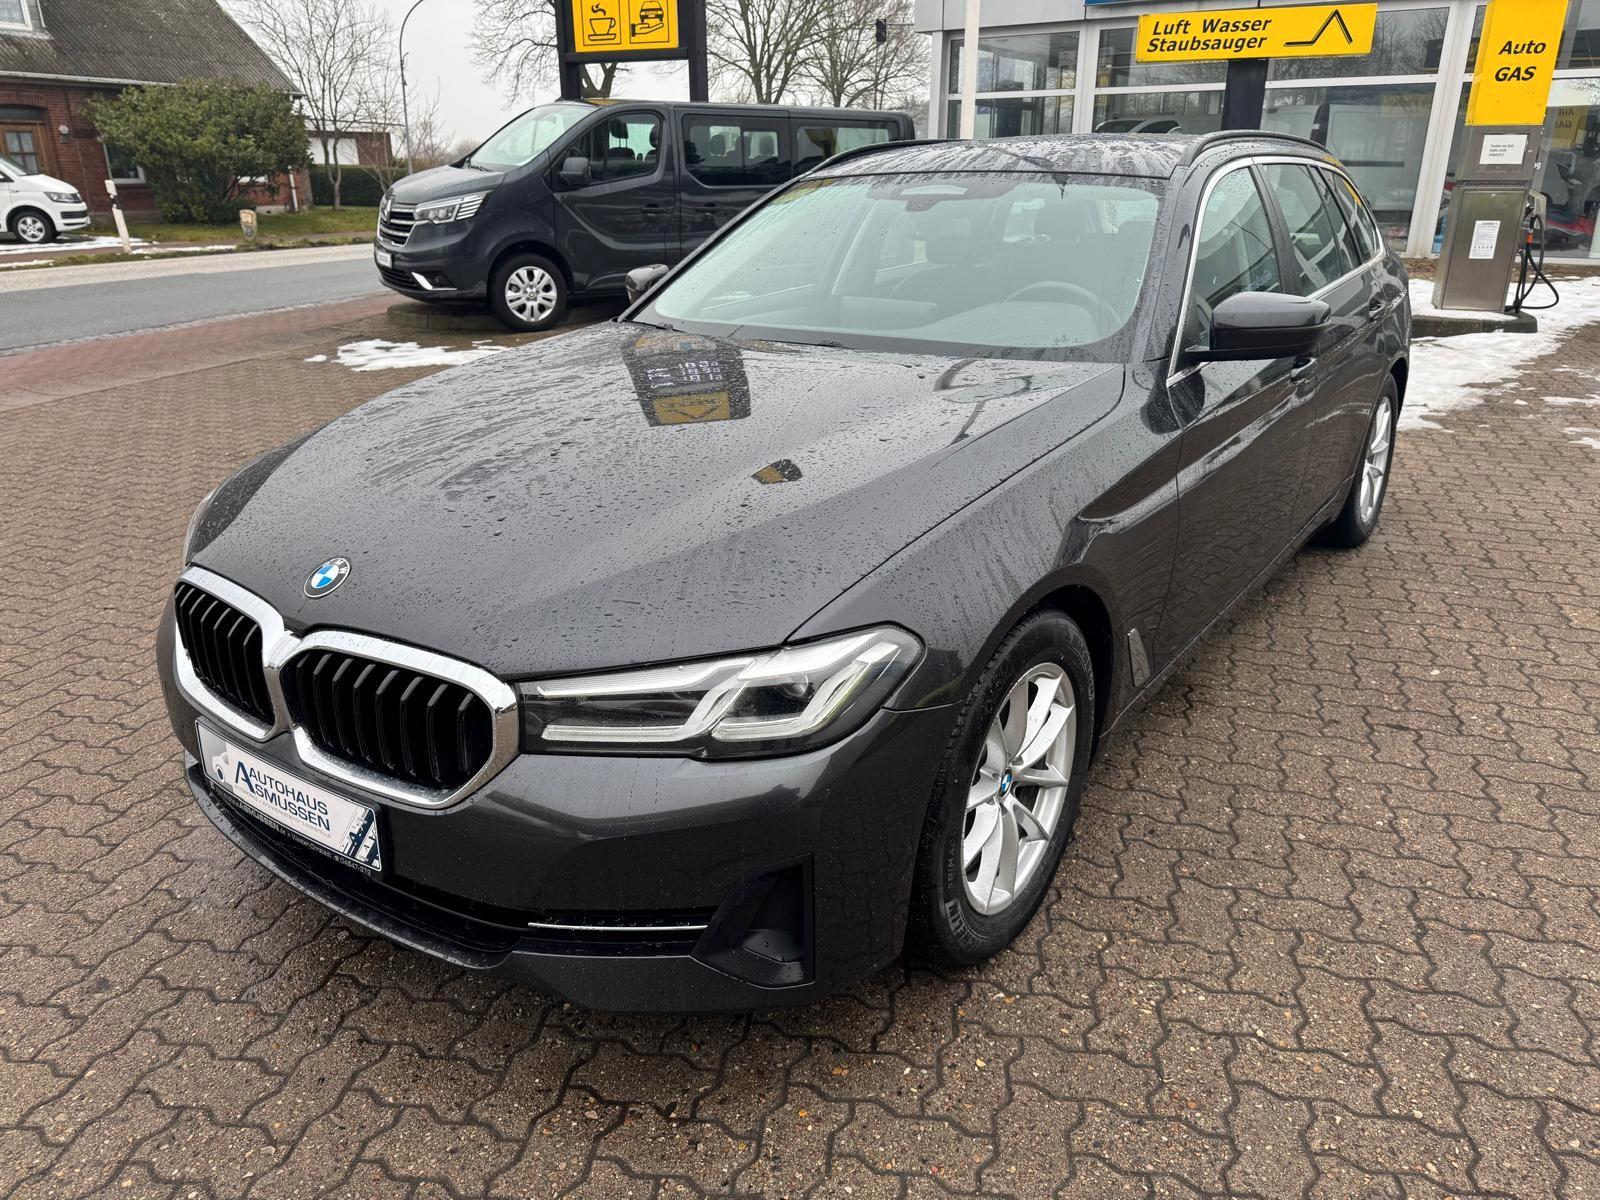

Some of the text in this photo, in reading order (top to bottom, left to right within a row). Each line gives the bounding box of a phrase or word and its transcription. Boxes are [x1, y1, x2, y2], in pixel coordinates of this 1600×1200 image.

[1152, 18, 1271, 36] Luft Wasser
[1147, 35, 1267, 53] Staubsauger
[1498, 39, 1547, 55] Auto
[1494, 66, 1537, 82] GAS
[249, 767, 328, 815] AUTOHAUS
